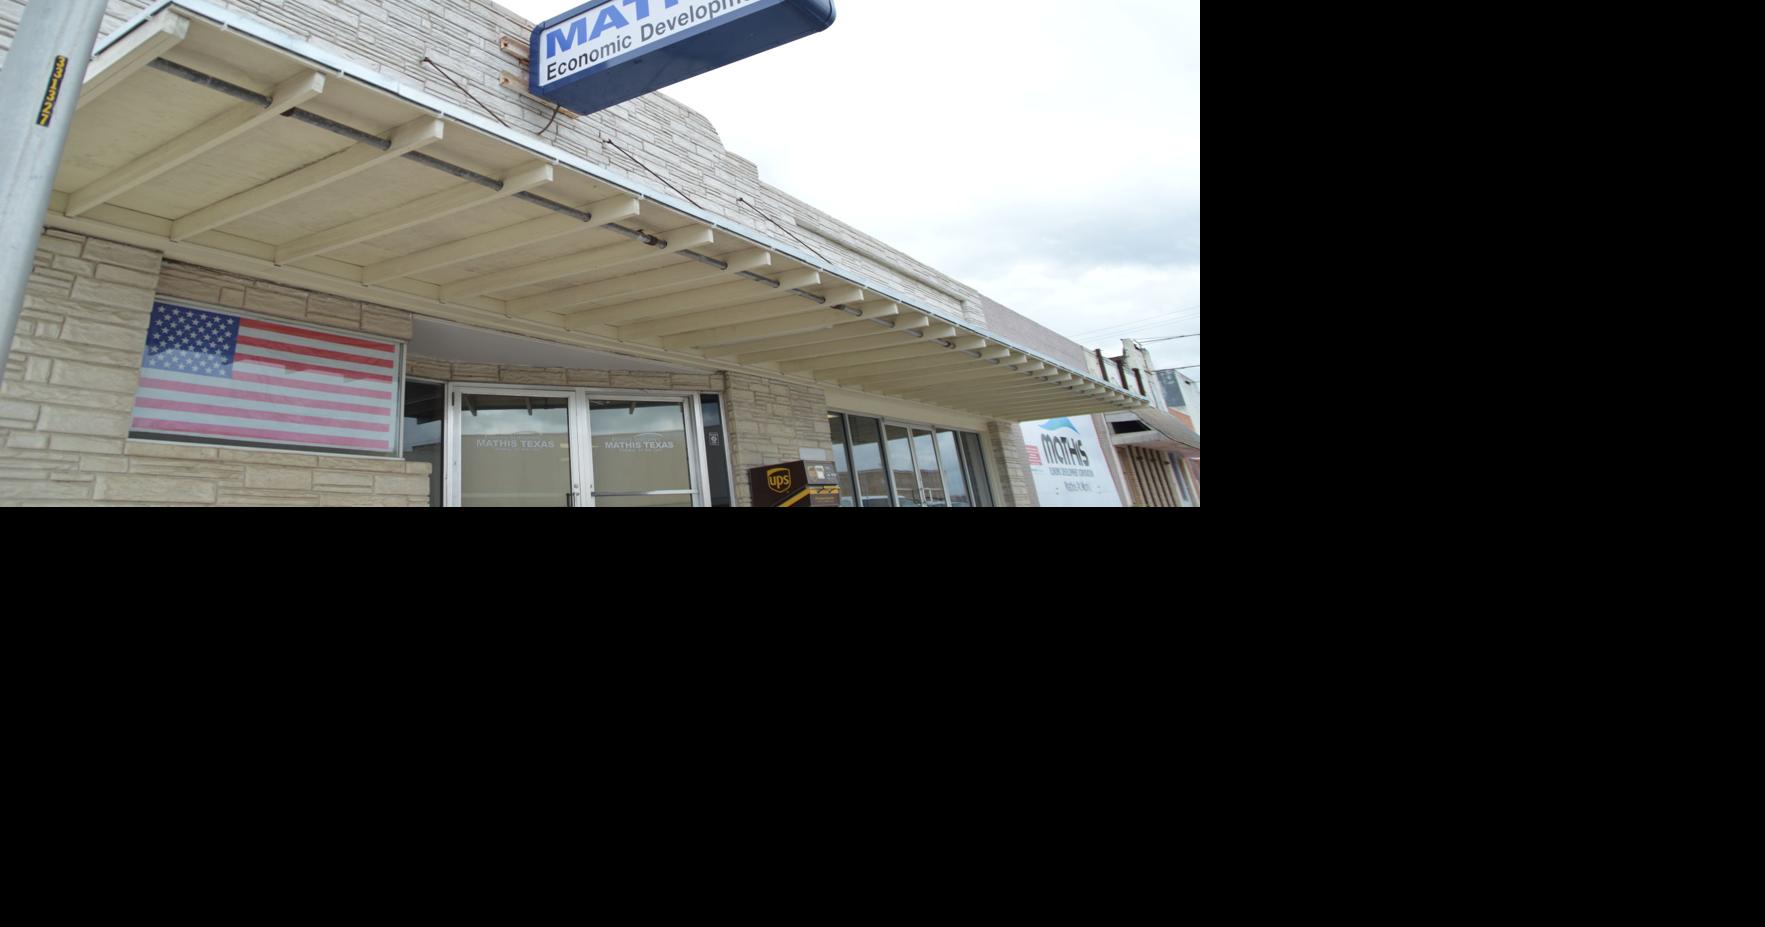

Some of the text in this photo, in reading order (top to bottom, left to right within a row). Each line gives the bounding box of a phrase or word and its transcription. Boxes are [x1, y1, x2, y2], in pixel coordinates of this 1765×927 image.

[547, 34, 632, 81] Economic
[40, 57, 65, 125] 331327
[476, 439, 555, 448] MATHIS TEXAS
[604, 441, 674, 449] MATHIS TEXAS
[769, 475, 789, 489] ups
